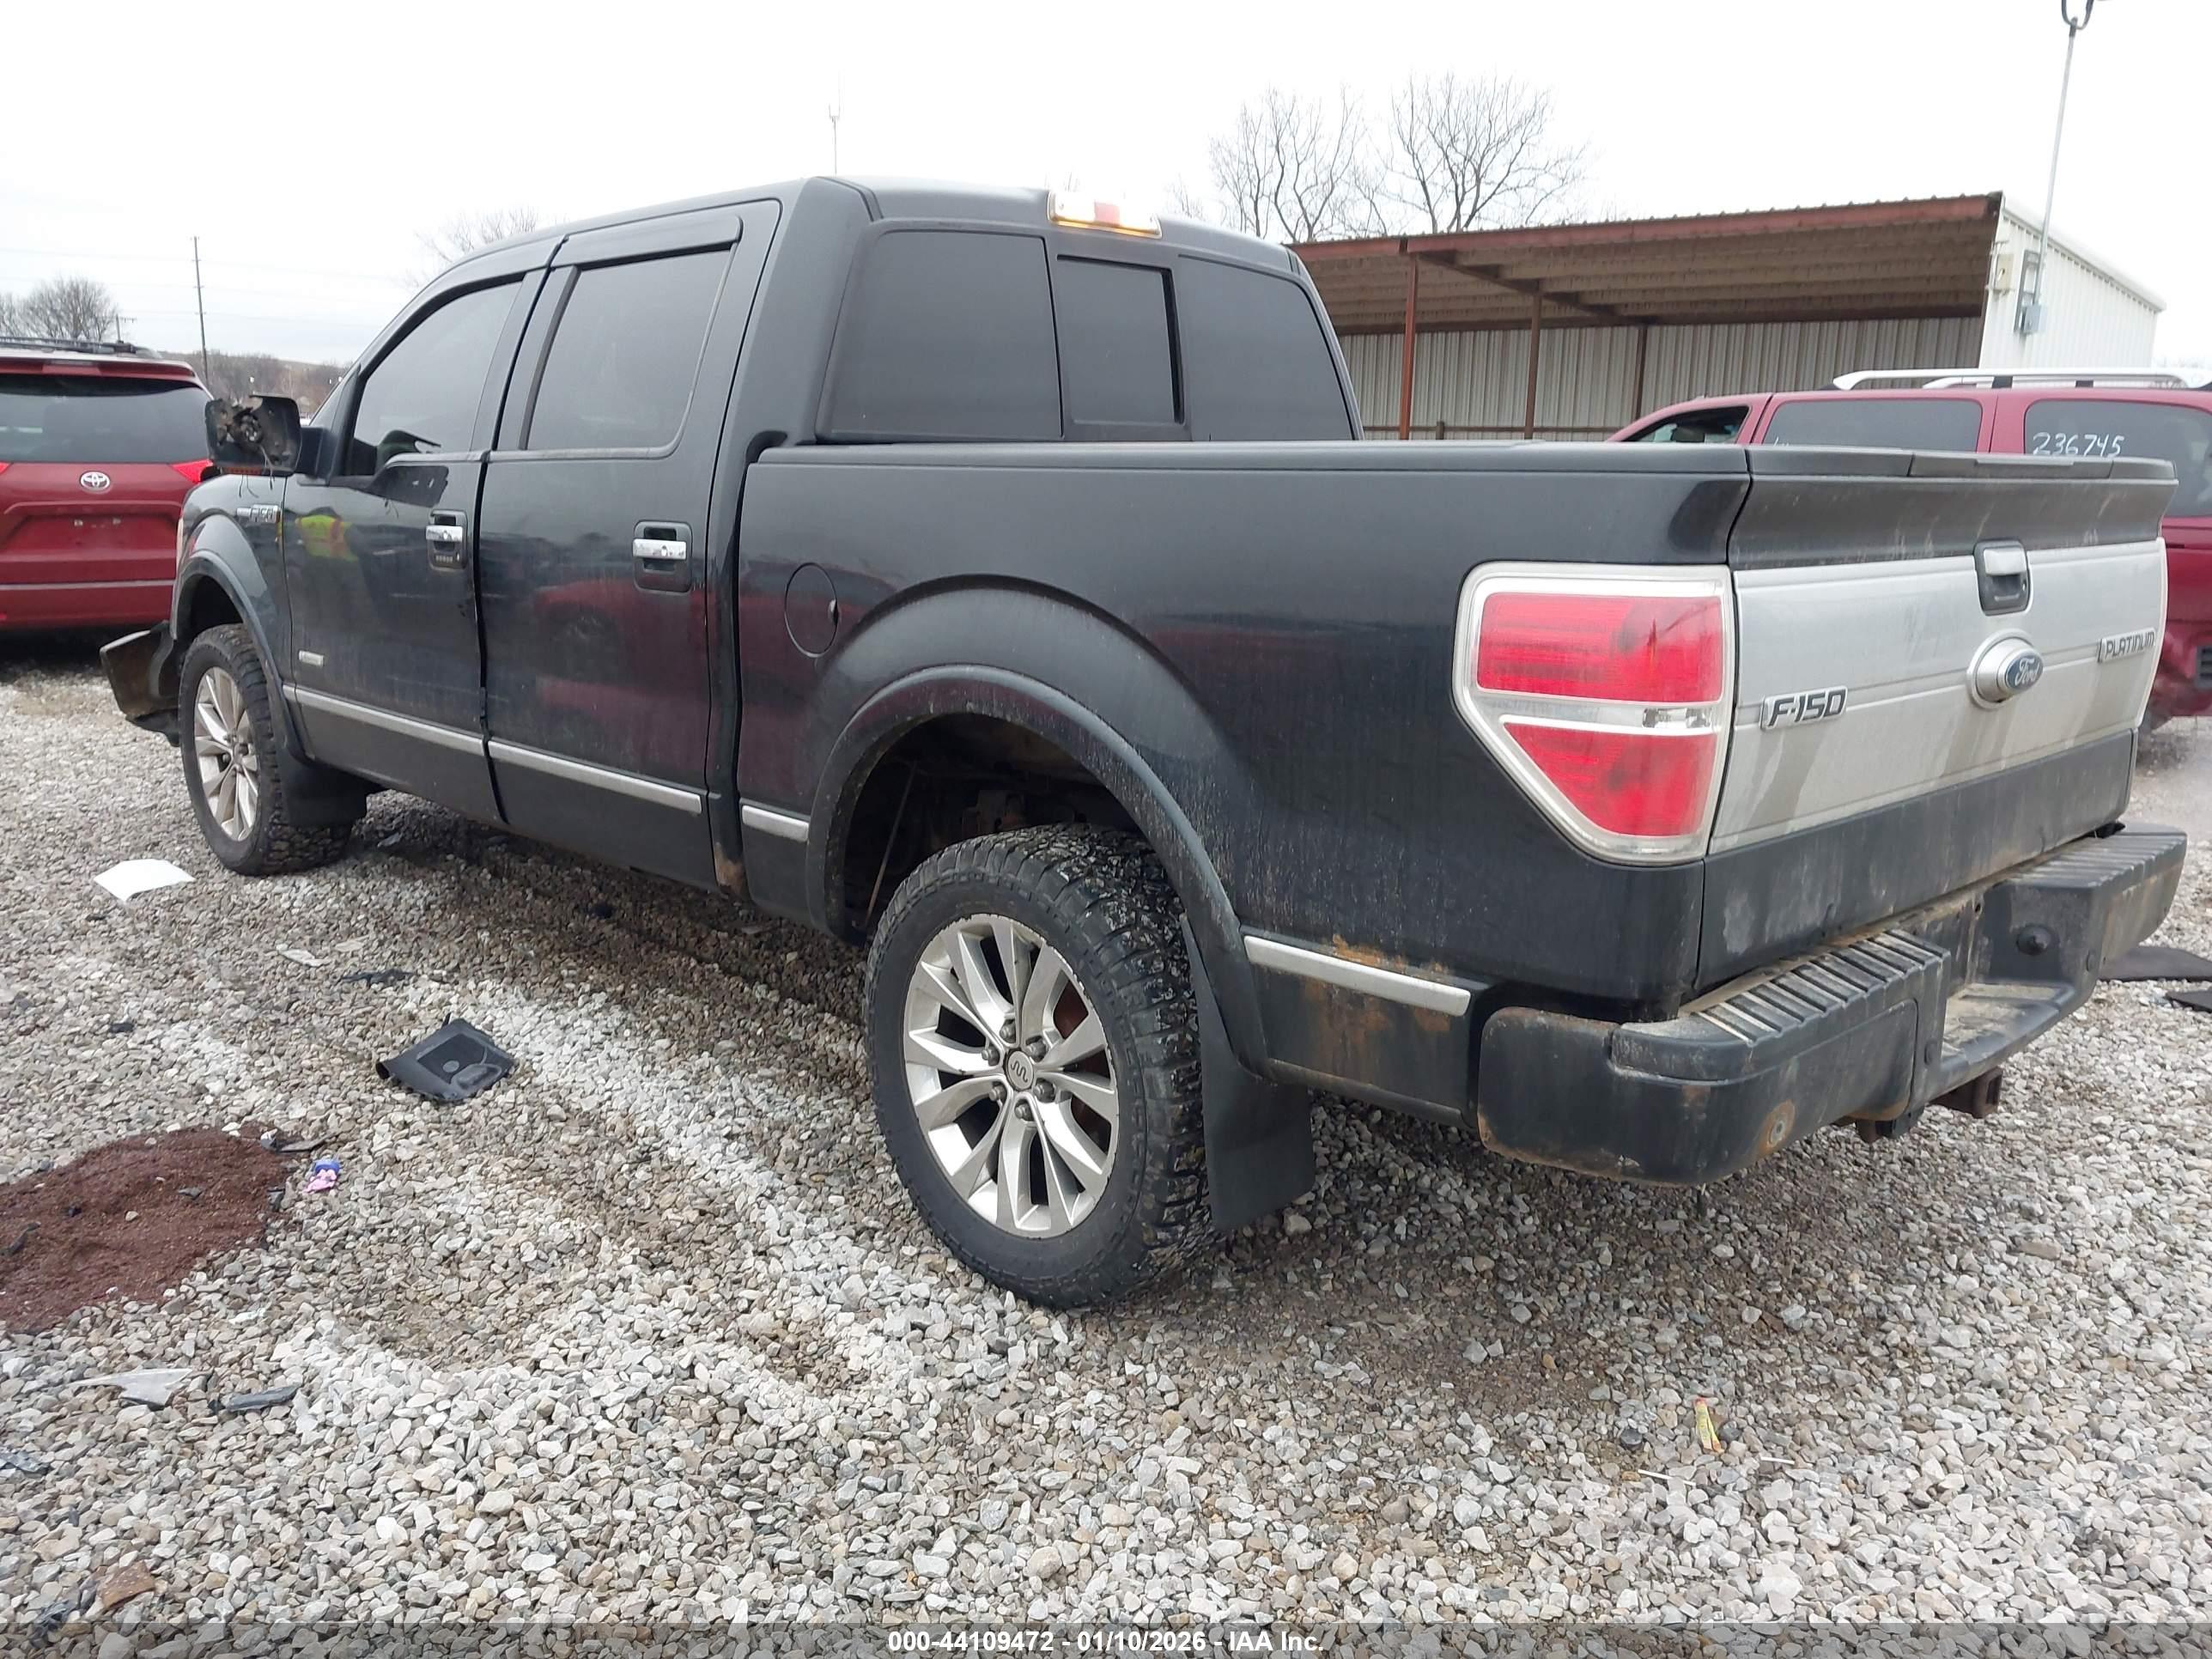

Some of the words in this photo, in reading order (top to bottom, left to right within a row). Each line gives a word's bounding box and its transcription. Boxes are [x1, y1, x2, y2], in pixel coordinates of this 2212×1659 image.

[2033, 432, 2125, 458] 236745
[2105, 631, 2155, 659] PLATINUM
[2014, 657, 2040, 686] Ford
